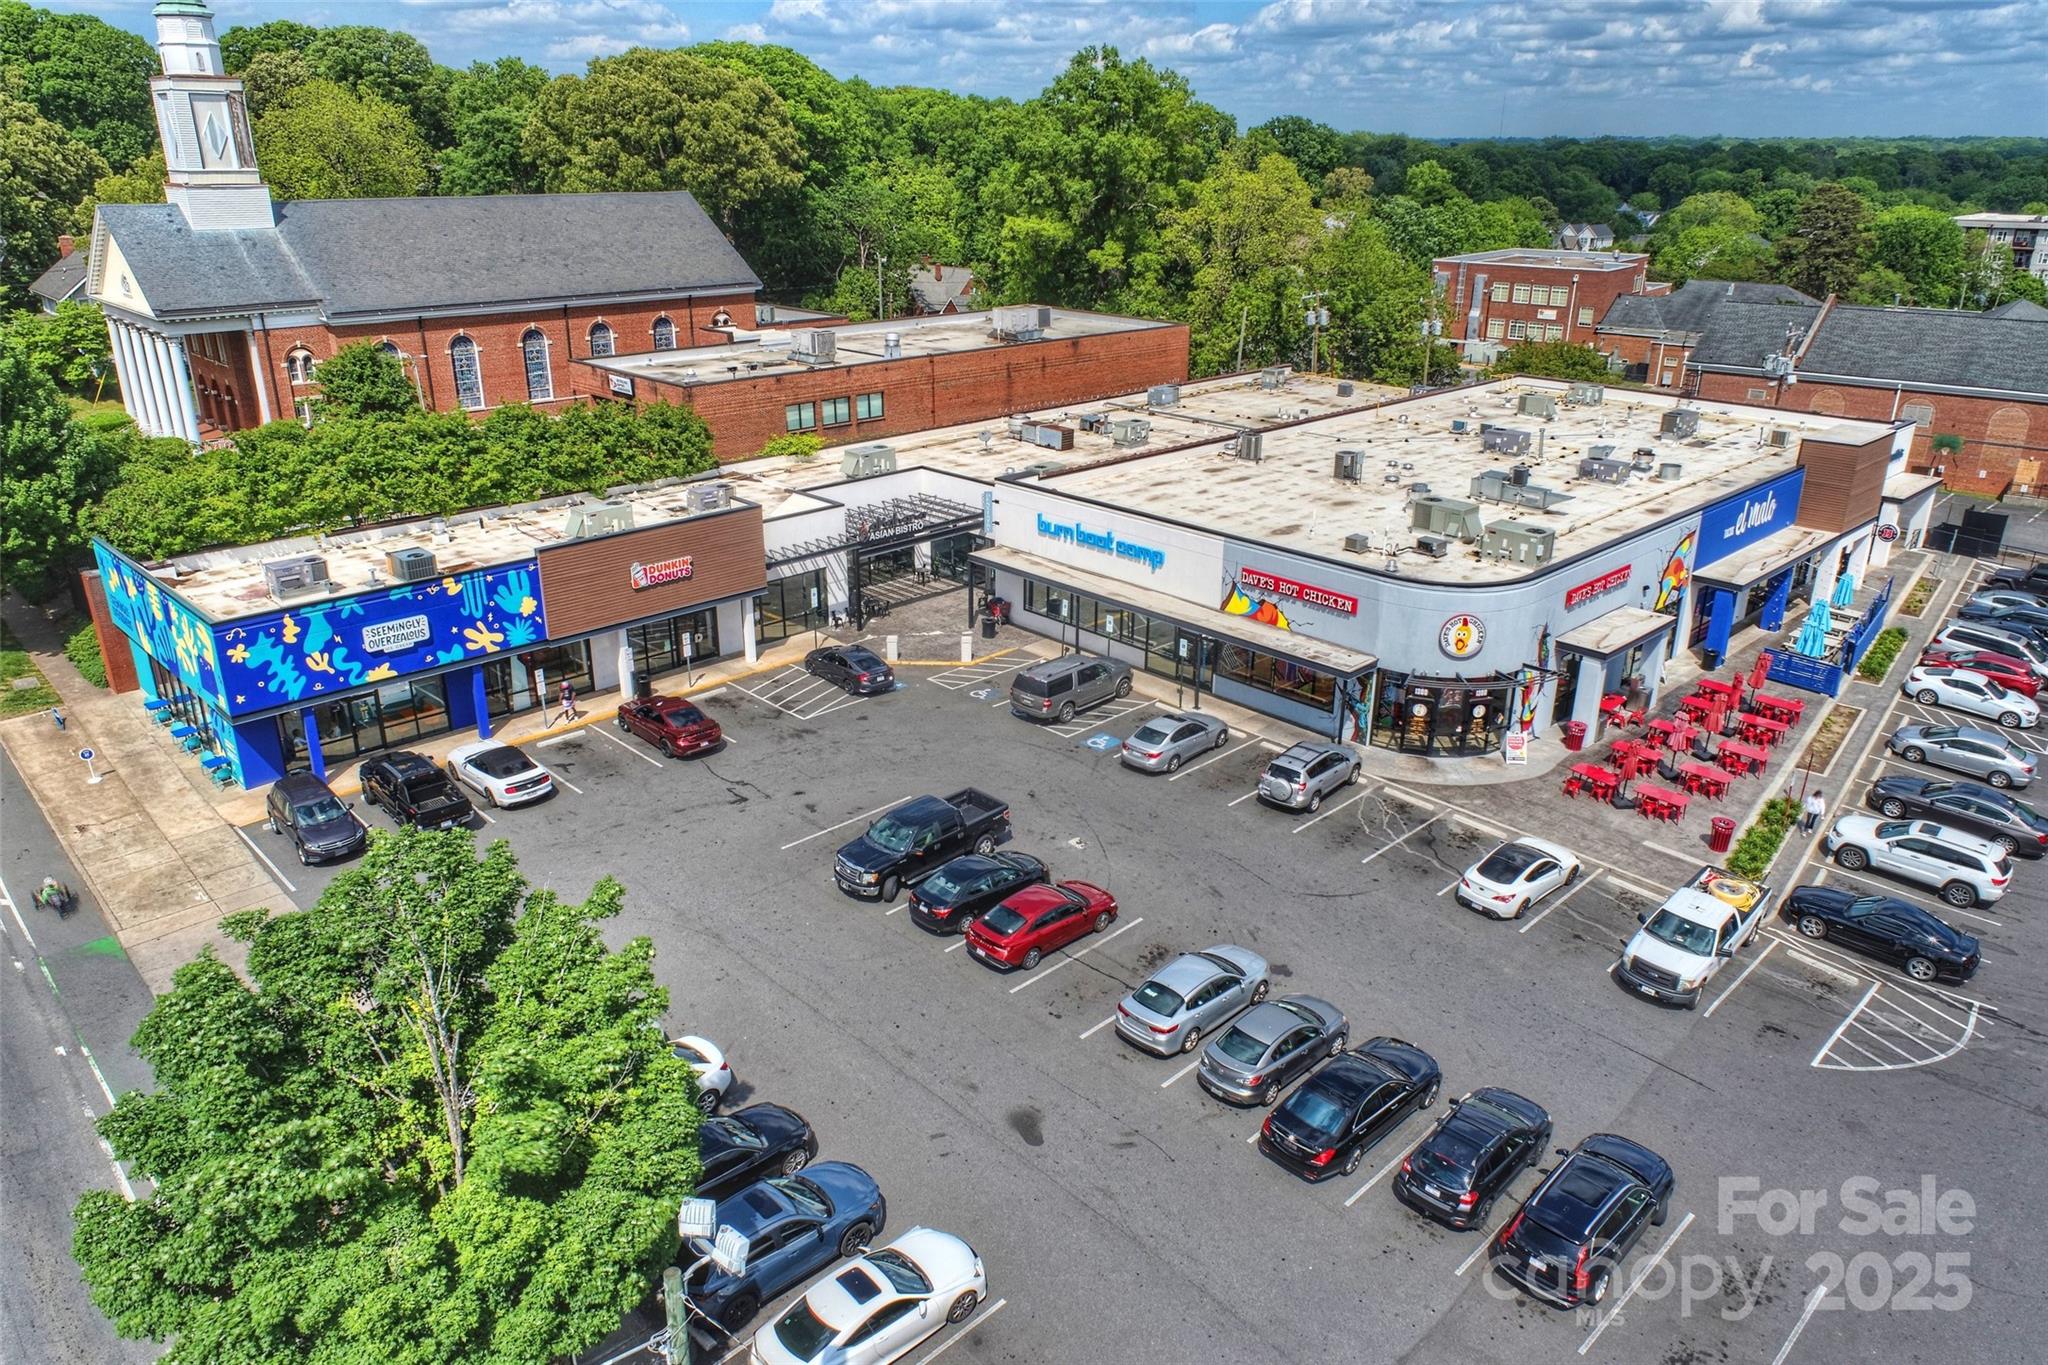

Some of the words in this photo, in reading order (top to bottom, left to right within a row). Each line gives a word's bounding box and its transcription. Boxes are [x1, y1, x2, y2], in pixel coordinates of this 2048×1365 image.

[1735, 500, 1750, 536] el
[869, 527, 894, 541] ASIAN
[895, 520, 924, 535] BISTRO
[1037, 512, 1074, 538] burn
[1076, 522, 1114, 551] boot
[1115, 539, 1165, 574] camp
[649, 566, 691, 584] DONUTS
[1241, 571, 1275, 591] DAVE'S
[1279, 581, 1300, 598] HOT
[1302, 588, 1353, 613] CHICKEN
[370, 618, 421, 637] SEEMINGLY
[368, 628, 426, 649] OVERZEALOUS
